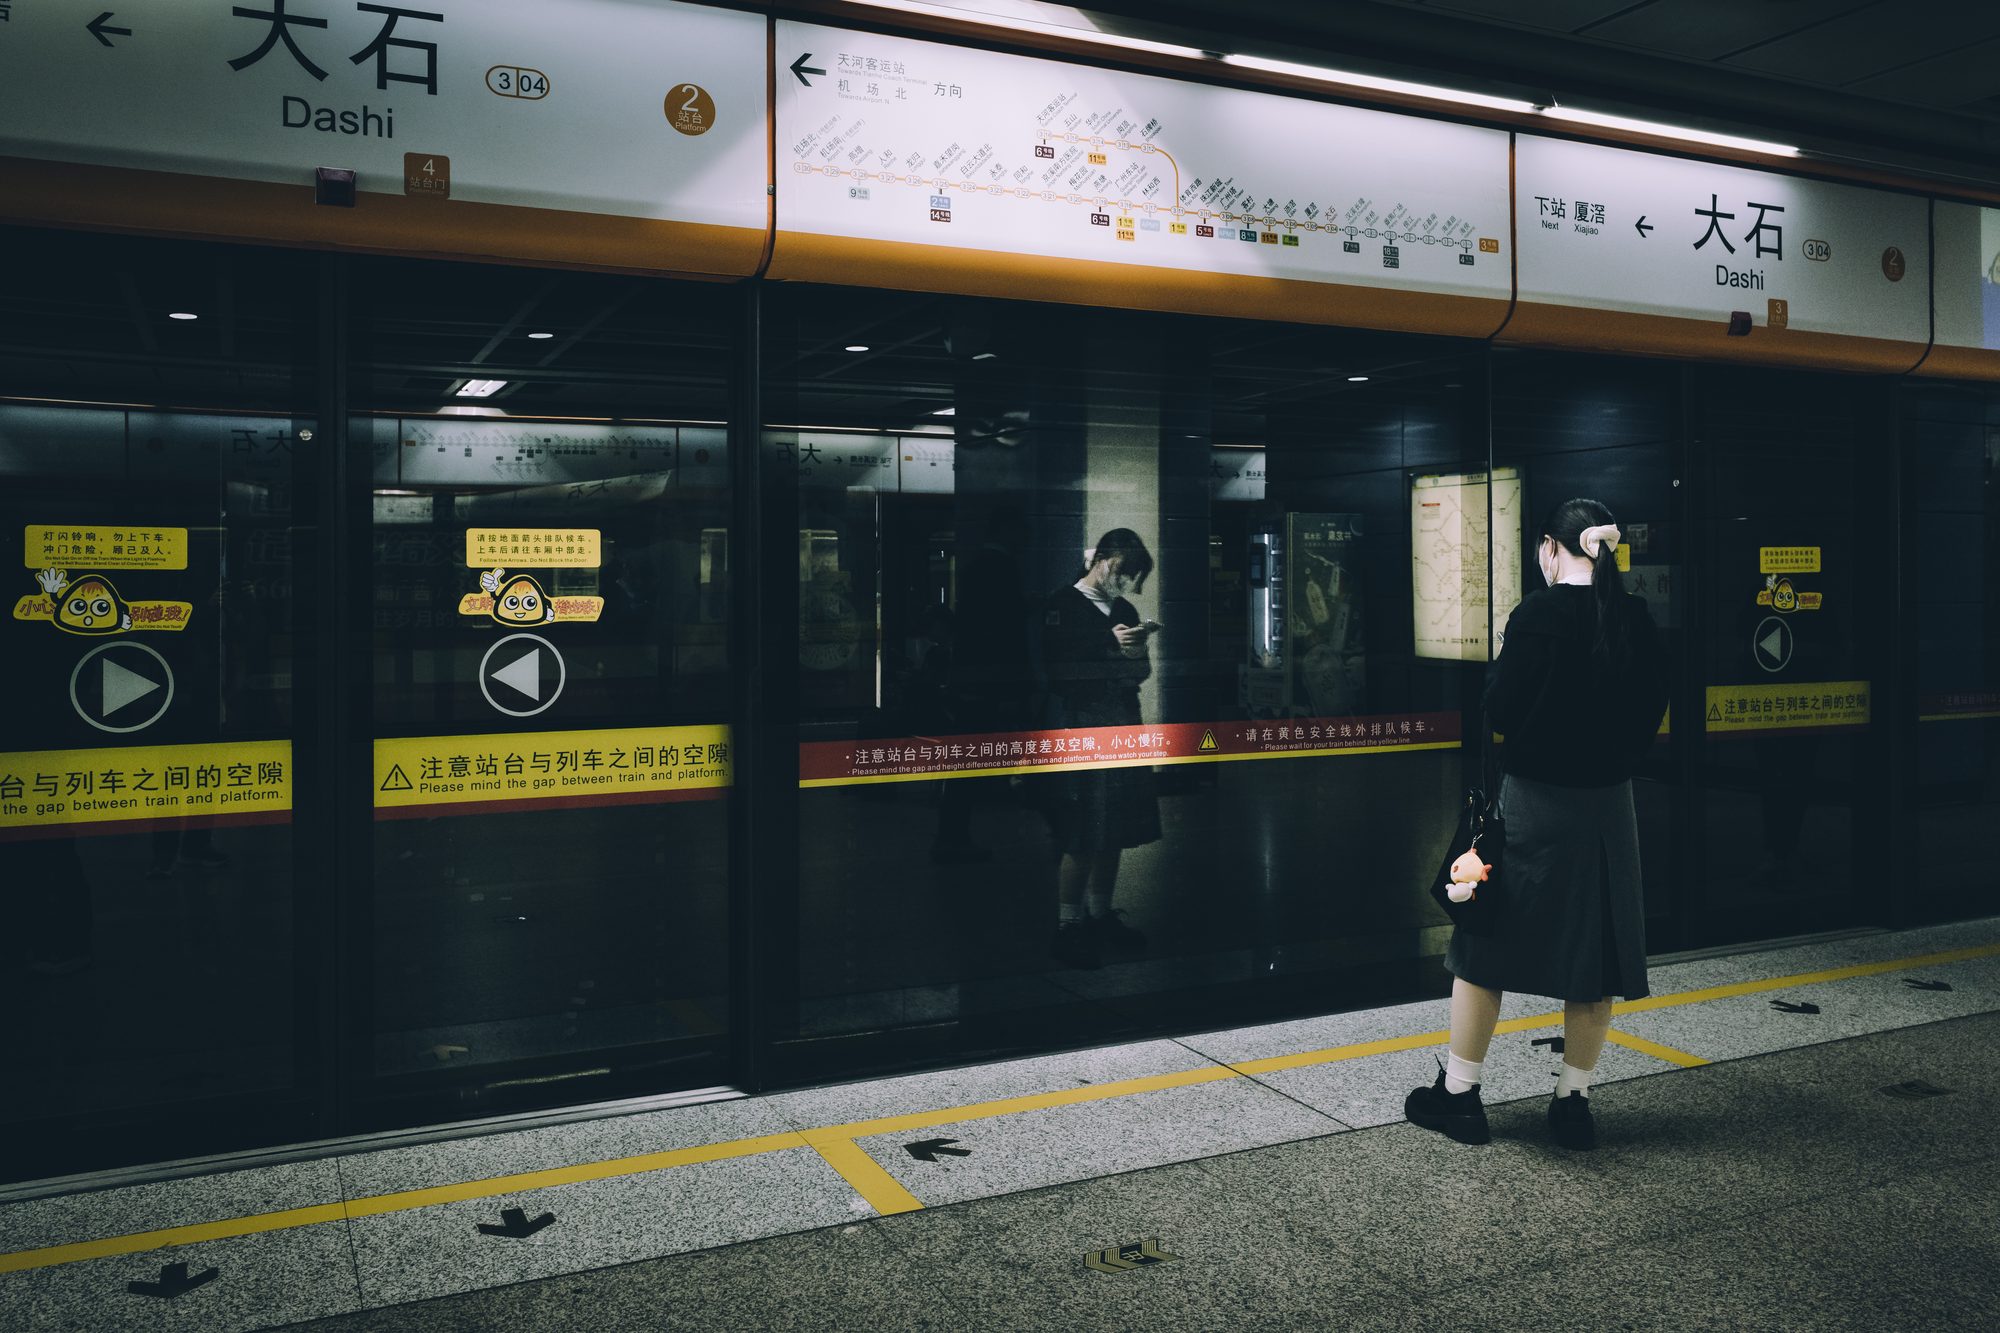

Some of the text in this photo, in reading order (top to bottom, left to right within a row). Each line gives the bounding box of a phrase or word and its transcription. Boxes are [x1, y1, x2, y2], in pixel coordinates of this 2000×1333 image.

[227, 0, 444, 94] 大石
[838, 53, 905, 74] 天河客运站
[498, 72, 545, 94] 3 04
[837, 67, 861, 77] Towards
[903, 76, 927, 85] Terminal
[838, 92, 861, 101] Towards
[934, 82, 962, 98] 方向
[682, 85, 698, 112] 2
[1035, 93, 1067, 122] 天河客运站
[282, 96, 393, 138] Dashi
[678, 111, 702, 124] 站台
[1063, 112, 1077, 127] 五山
[1085, 112, 1099, 126] 华师
[676, 122, 706, 132] Platform
[1139, 118, 1159, 137] 石牌桥
[792, 132, 816, 154] 机场北
[819, 136, 842, 157] 机场南
[846, 145, 864, 161] 高增
[877, 149, 893, 164] 人和
[904, 151, 921, 168] 龙归
[932, 142, 960, 168] 嘉禾望岗
[959, 142, 993, 174] 白云大道北
[1036, 148, 1042, 157] 6
[1089, 154, 1097, 163] 11
[423, 159, 435, 175] 4
[1040, 145, 1079, 181] 京溪南方医院
[1013, 165, 1028, 180] 同和
[1067, 166, 1088, 186] 梅花园
[1112, 162, 1139, 187] 广州东站
[409, 176, 445, 189] 站台门
[1141, 176, 1161, 195] 林和西
[1180, 178, 1202, 202] 体育西路
[1199, 178, 1223, 203] 珠江新城
[850, 189, 857, 198] 9
[1218, 186, 1237, 206] 广州塔
[932, 198, 938, 207] 2
[1240, 195, 1254, 209] 客村
[930, 210, 940, 220] 14
[1323, 206, 1336, 219] 大石
[1534, 196, 1605, 225] 下站 厦滘
[1092, 215, 1098, 224] 6
[1118, 218, 1122, 227] 1
[1542, 219, 1598, 236] Next Xiajiao
[1693, 194, 1785, 260] 大石
[1117, 231, 1125, 239] 11
[1171, 224, 1175, 232] 1
[1197, 227, 1203, 235] 5
[1241, 231, 1246, 240] 8
[1345, 243, 1350, 251] 7
[1384, 248, 1391, 256] 18
[1481, 240, 1487, 250] 3
[1808, 244, 1829, 256] 3 04
[1384, 258, 1391, 267] 22
[1889, 247, 1898, 266] 2
[1716, 265, 1764, 290] Dashi
[1776, 303, 1781, 313] 3
[1245, 721, 1436, 742] 请在黄色安全线外排队候车。
[1264, 742, 1287, 751] Please
[1303, 741, 1312, 749] for
[1313, 741, 1327, 749] your
[1329, 740, 1343, 748] train
[1367, 738, 1377, 746] the
[1378, 737, 1397, 746] yellow
[419, 743, 728, 780] 注意站台与列车之间的空隙
[852, 767, 878, 776] Please
[880, 766, 898, 774] mind
[899, 765, 911, 773] the
[912, 765, 926, 774] gap
[927, 764, 941, 772] and
[942, 762, 965, 772] height
[966, 760, 1001, 770] difference
[1002, 759, 1031, 768] between
[1033, 757, 1048, 766] train
[1063, 754, 1092, 764] platform.
[1094, 752, 1117, 761] Please
[1118, 752, 1137, 760] watch
[1138, 751, 1151, 760] your
[0, 761, 283, 800] 台与列车之间的空隙
[420, 768, 728, 793] Please mind the gap between train and platform.
[3, 789, 283, 815] the gap between train and platform.
